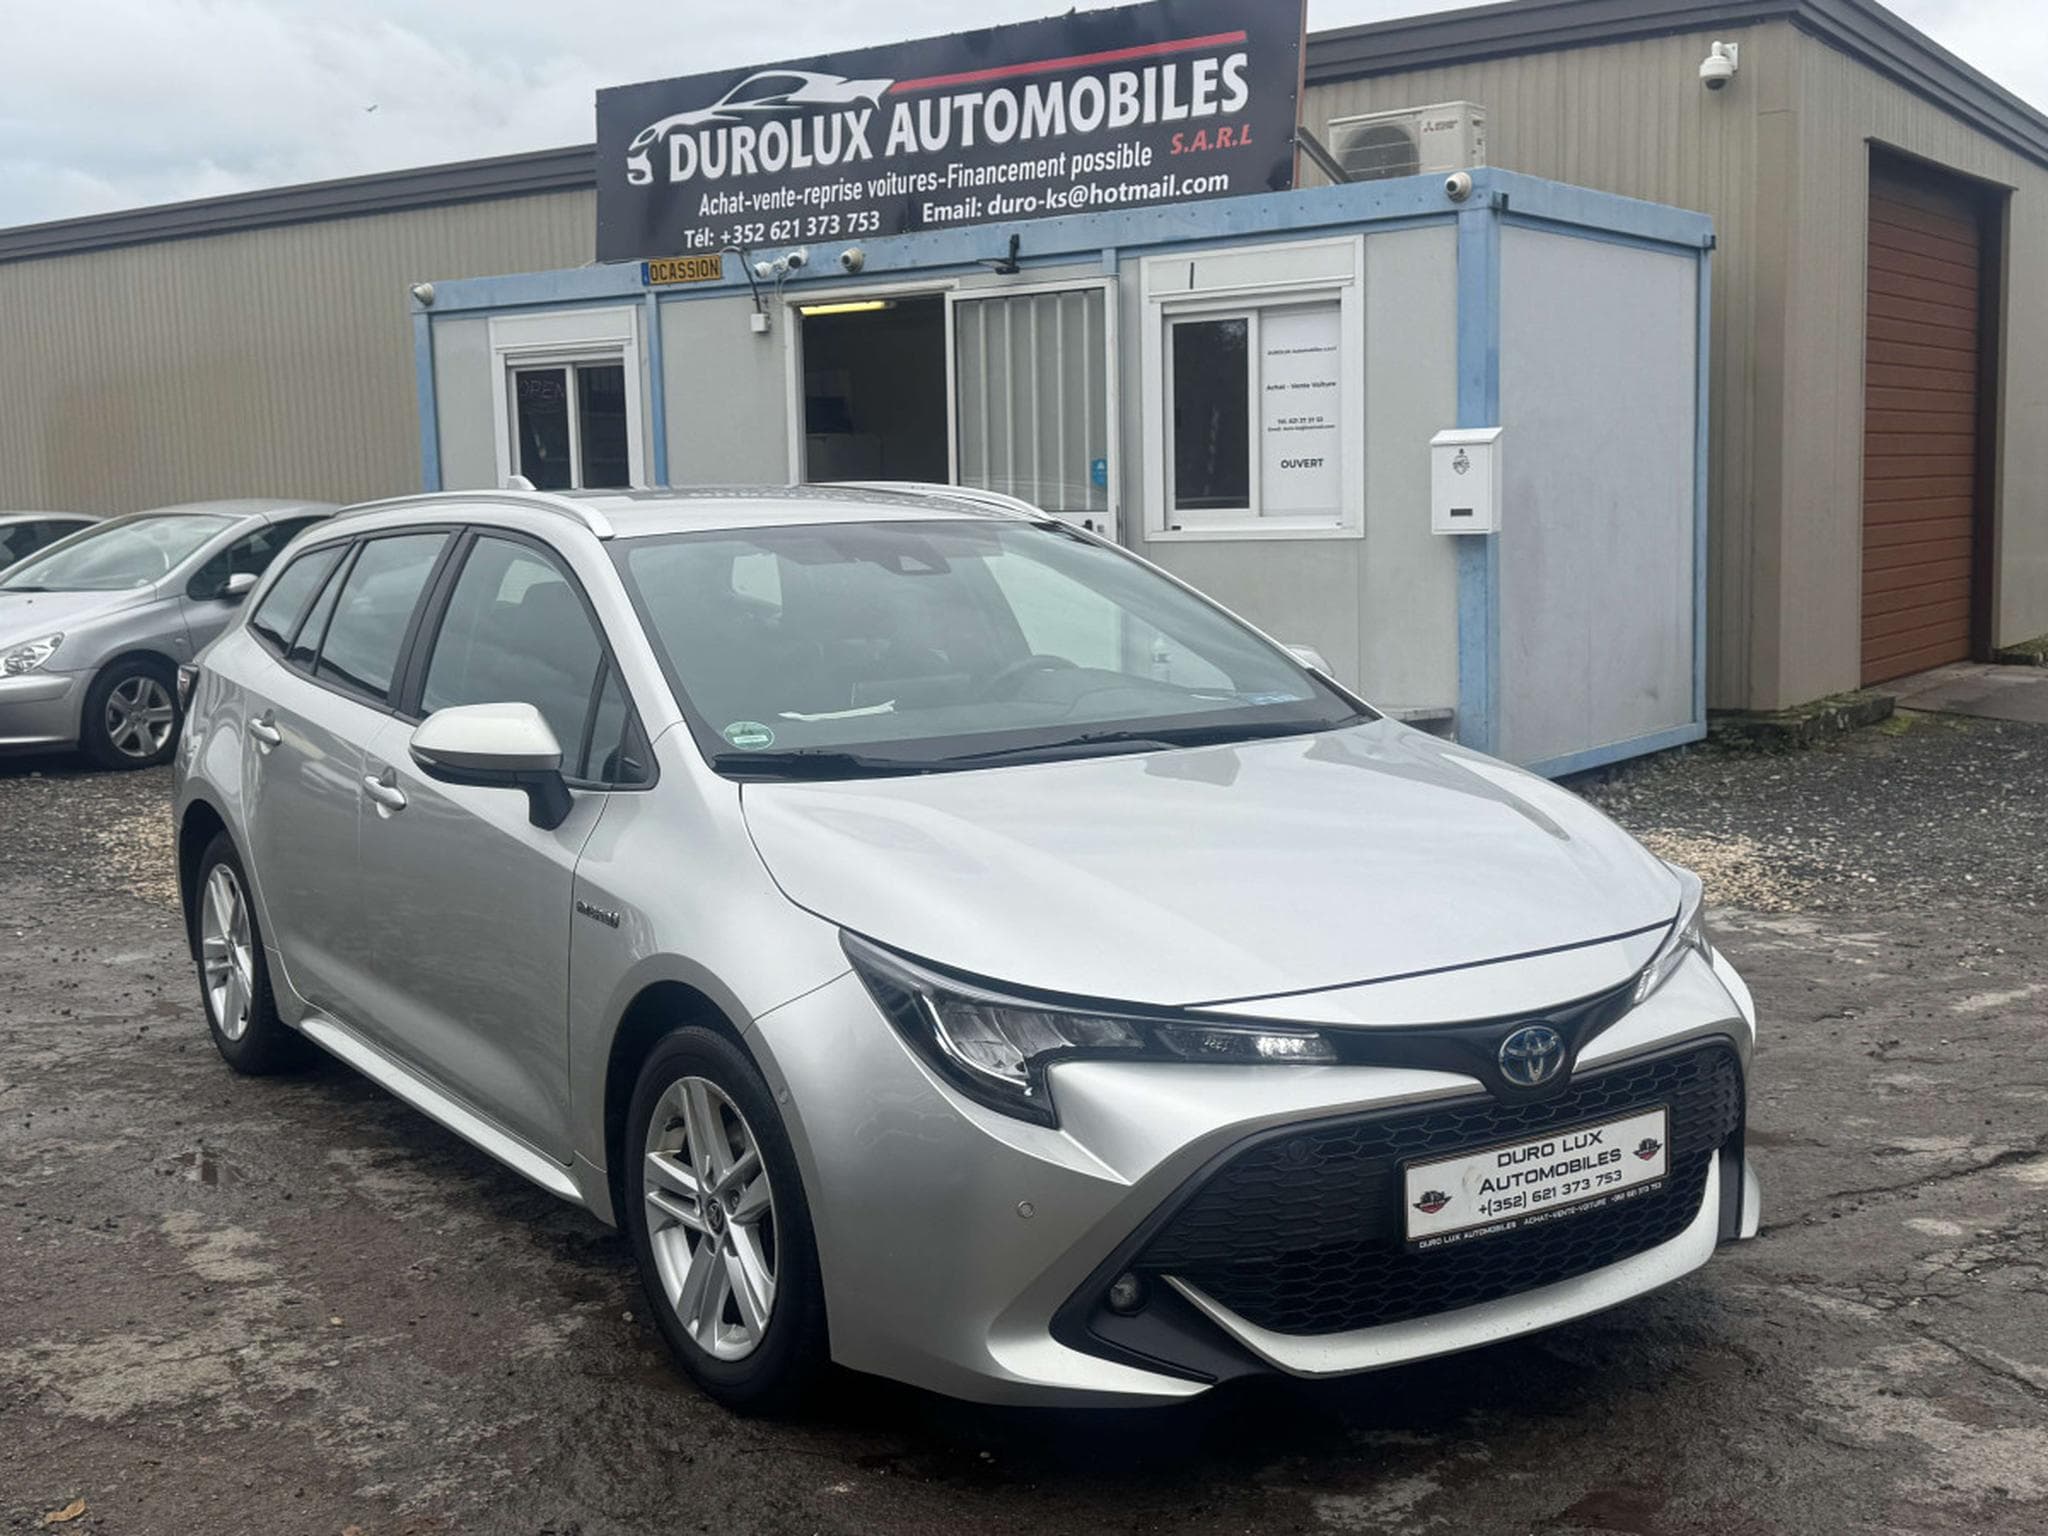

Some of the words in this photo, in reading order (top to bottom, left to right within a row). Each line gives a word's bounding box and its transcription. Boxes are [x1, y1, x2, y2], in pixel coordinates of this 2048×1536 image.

[669, 108, 873, 182] DUROLUX
[885, 53, 1249, 156] AUTOMOBILES
[1170, 124, 1253, 156] S.A.R.L
[699, 178, 862, 216] Achat-vente-reprise
[868, 152, 1066, 198] voitures-Financement
[1071, 142, 1152, 180] possible
[922, 194, 982, 223] Email:
[987, 174, 1229, 216] duro-ks@hotmail.com
[684, 228, 714, 249] Tél:
[720, 223, 764, 245] +352
[770, 219, 800, 241] 621
[806, 214, 841, 236] 373
[847, 211, 880, 233] 753
[650, 259, 719, 281] OCASSION
[1280, 458, 1324, 469] OUVERT
[1497, 1142, 1556, 1168] DURO
[1562, 1131, 1604, 1153] LUX
[1478, 1149, 1622, 1196] AUTOMOBILES
[1478, 1191, 1527, 1217] +(352)
[1532, 1186, 1556, 1203] 621
[1561, 1179, 1590, 1196] 373
[1596, 1170, 1622, 1187] 753
[1419, 1238, 1442, 1249] DURO
[1444, 1234, 1461, 1244] LUX
